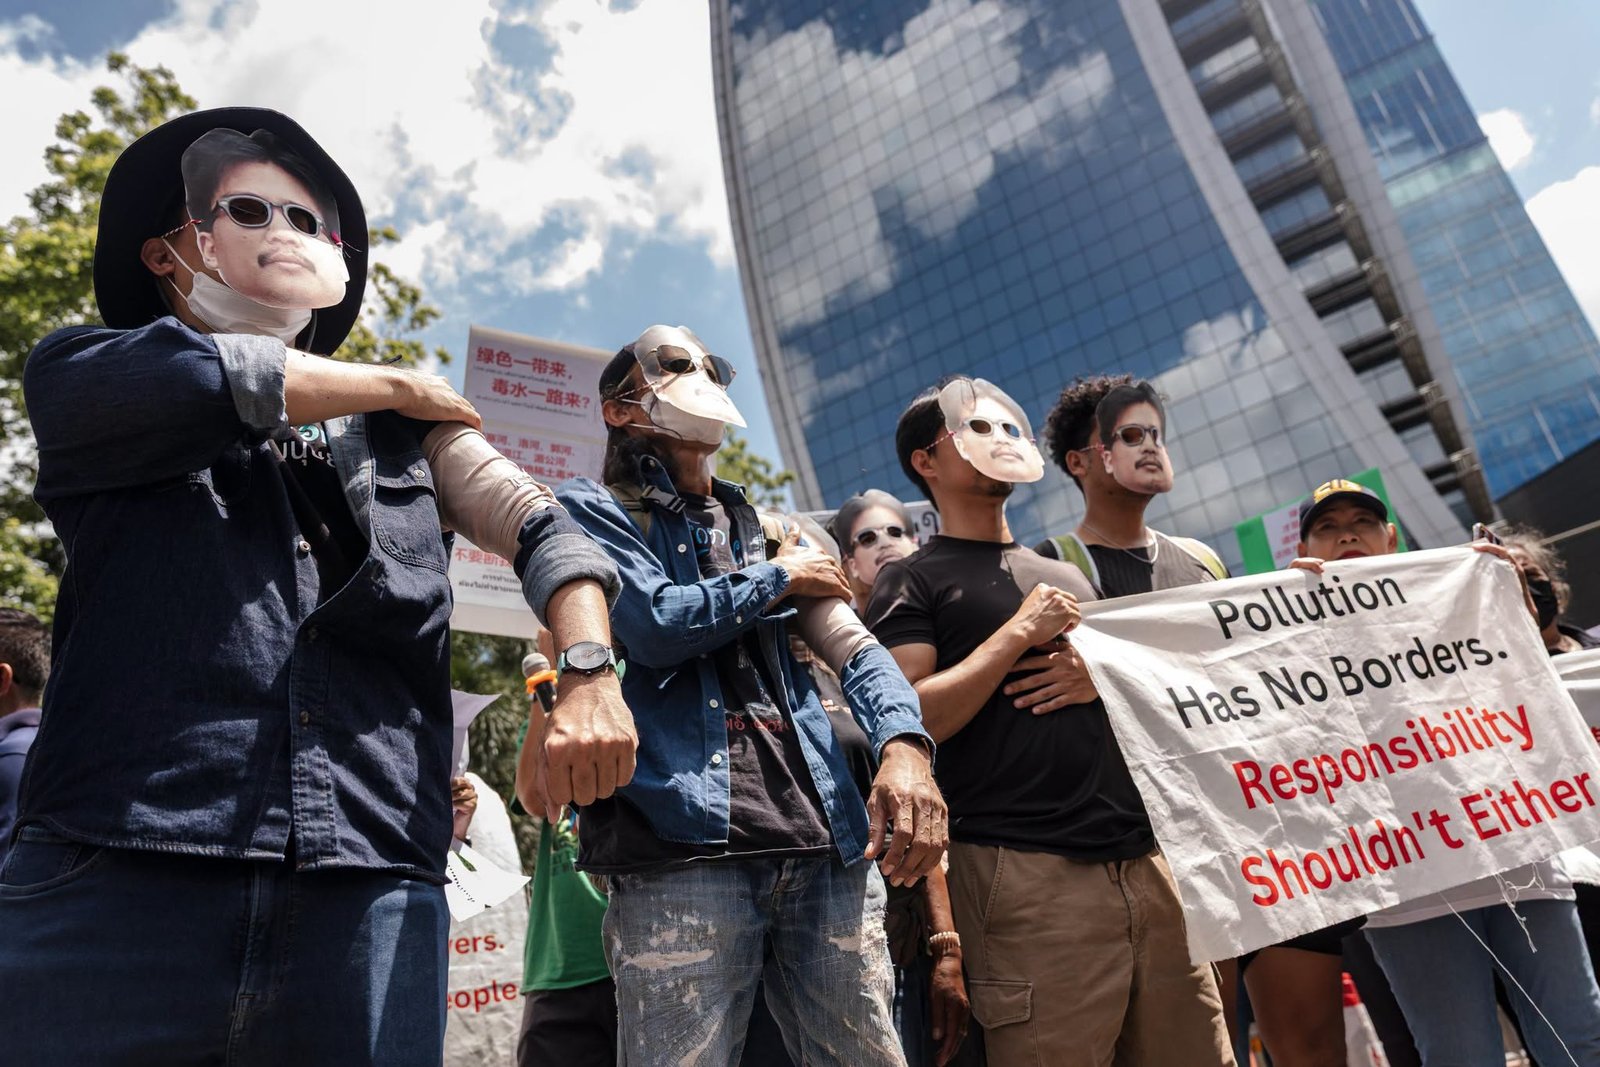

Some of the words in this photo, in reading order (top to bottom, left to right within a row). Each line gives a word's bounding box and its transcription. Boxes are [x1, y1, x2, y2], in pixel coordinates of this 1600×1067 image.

[1208, 576, 1407, 640] Pollution
[1166, 684, 1261, 729] Has
[1258, 665, 1328, 710] No
[1330, 635, 1508, 697] Borders.
[1232, 704, 1535, 810] Responsibility
[1240, 808, 1465, 907] Shouldn't
[1461, 770, 1596, 841] Either
